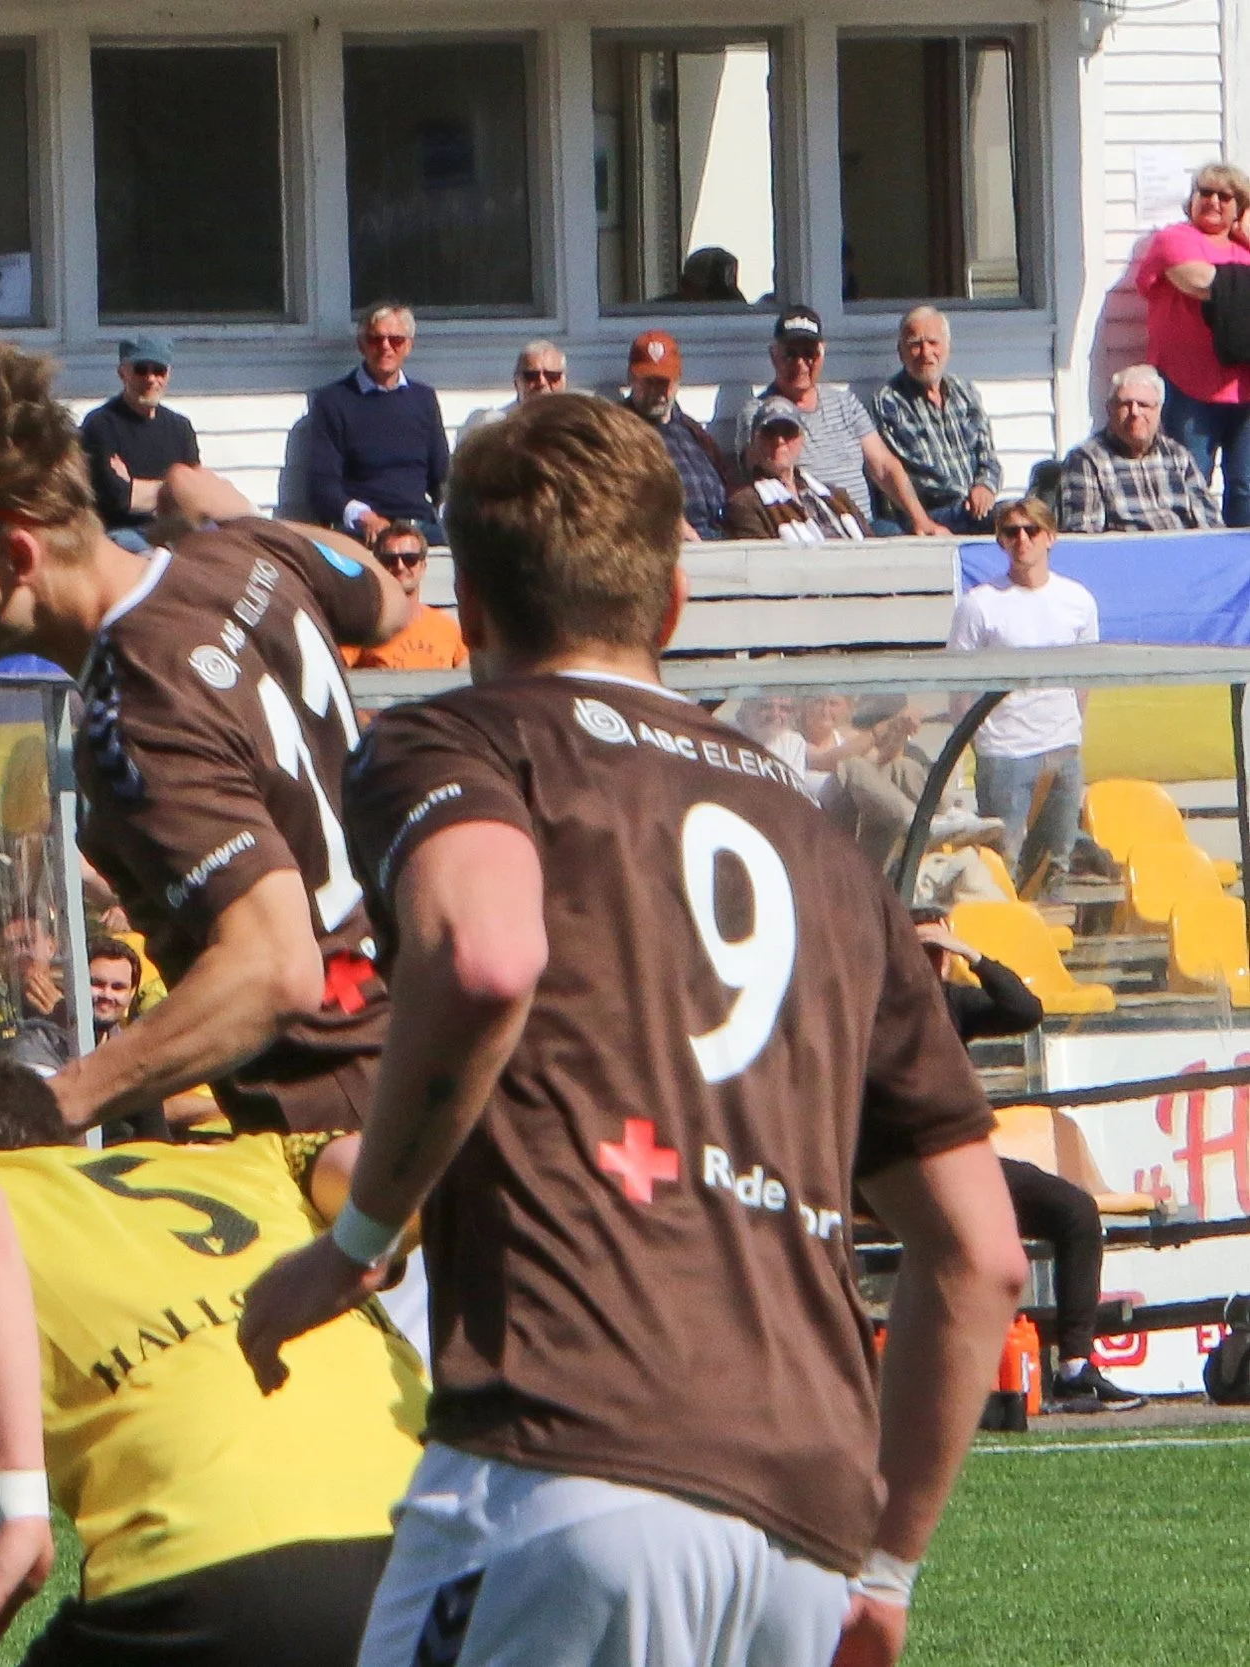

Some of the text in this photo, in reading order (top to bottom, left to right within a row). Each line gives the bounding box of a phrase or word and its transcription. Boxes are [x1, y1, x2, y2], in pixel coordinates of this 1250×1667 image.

[638, 721, 699, 761] ABC
[681, 801, 798, 1086] 9
[70, 1155, 260, 1258] 5
[703, 1143, 787, 1212] Rde
